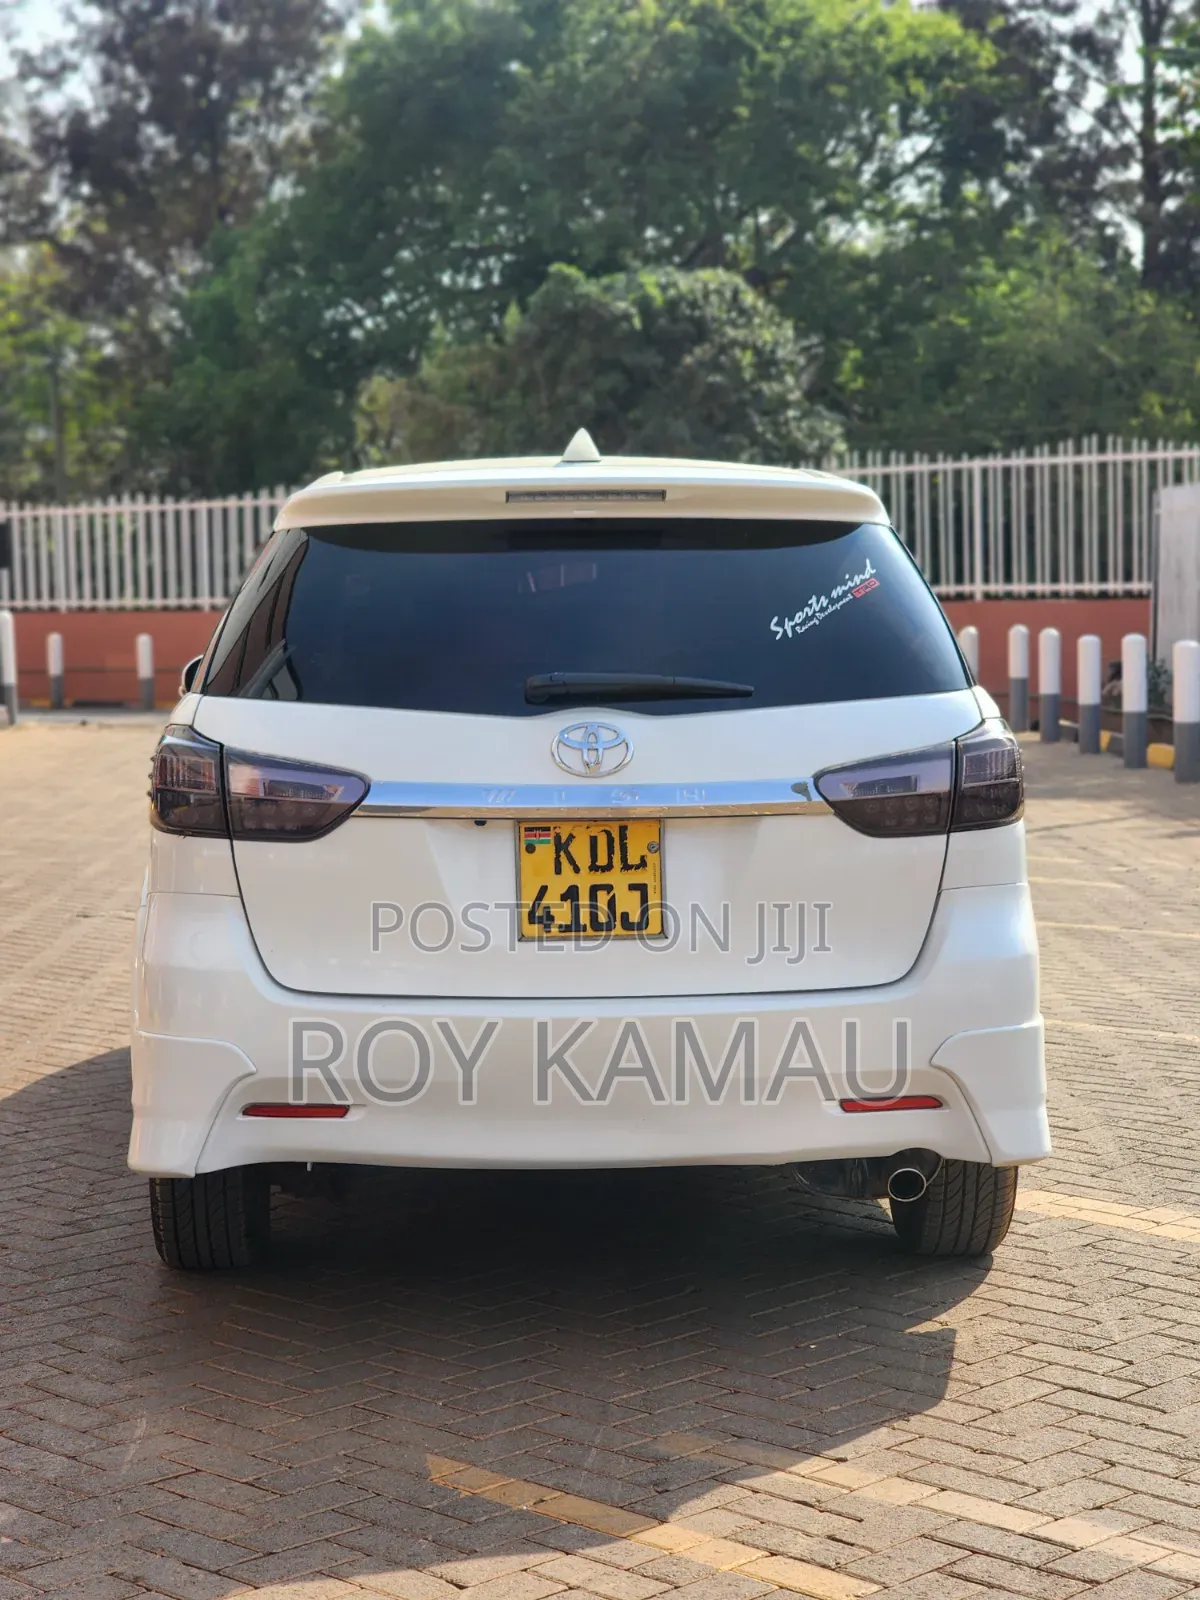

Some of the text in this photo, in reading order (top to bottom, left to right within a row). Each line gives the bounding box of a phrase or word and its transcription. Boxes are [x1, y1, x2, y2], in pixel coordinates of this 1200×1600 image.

[770, 558, 877, 640] Sports mind
[553, 824, 648, 876] KDL
[528, 883, 650, 933] 410J
